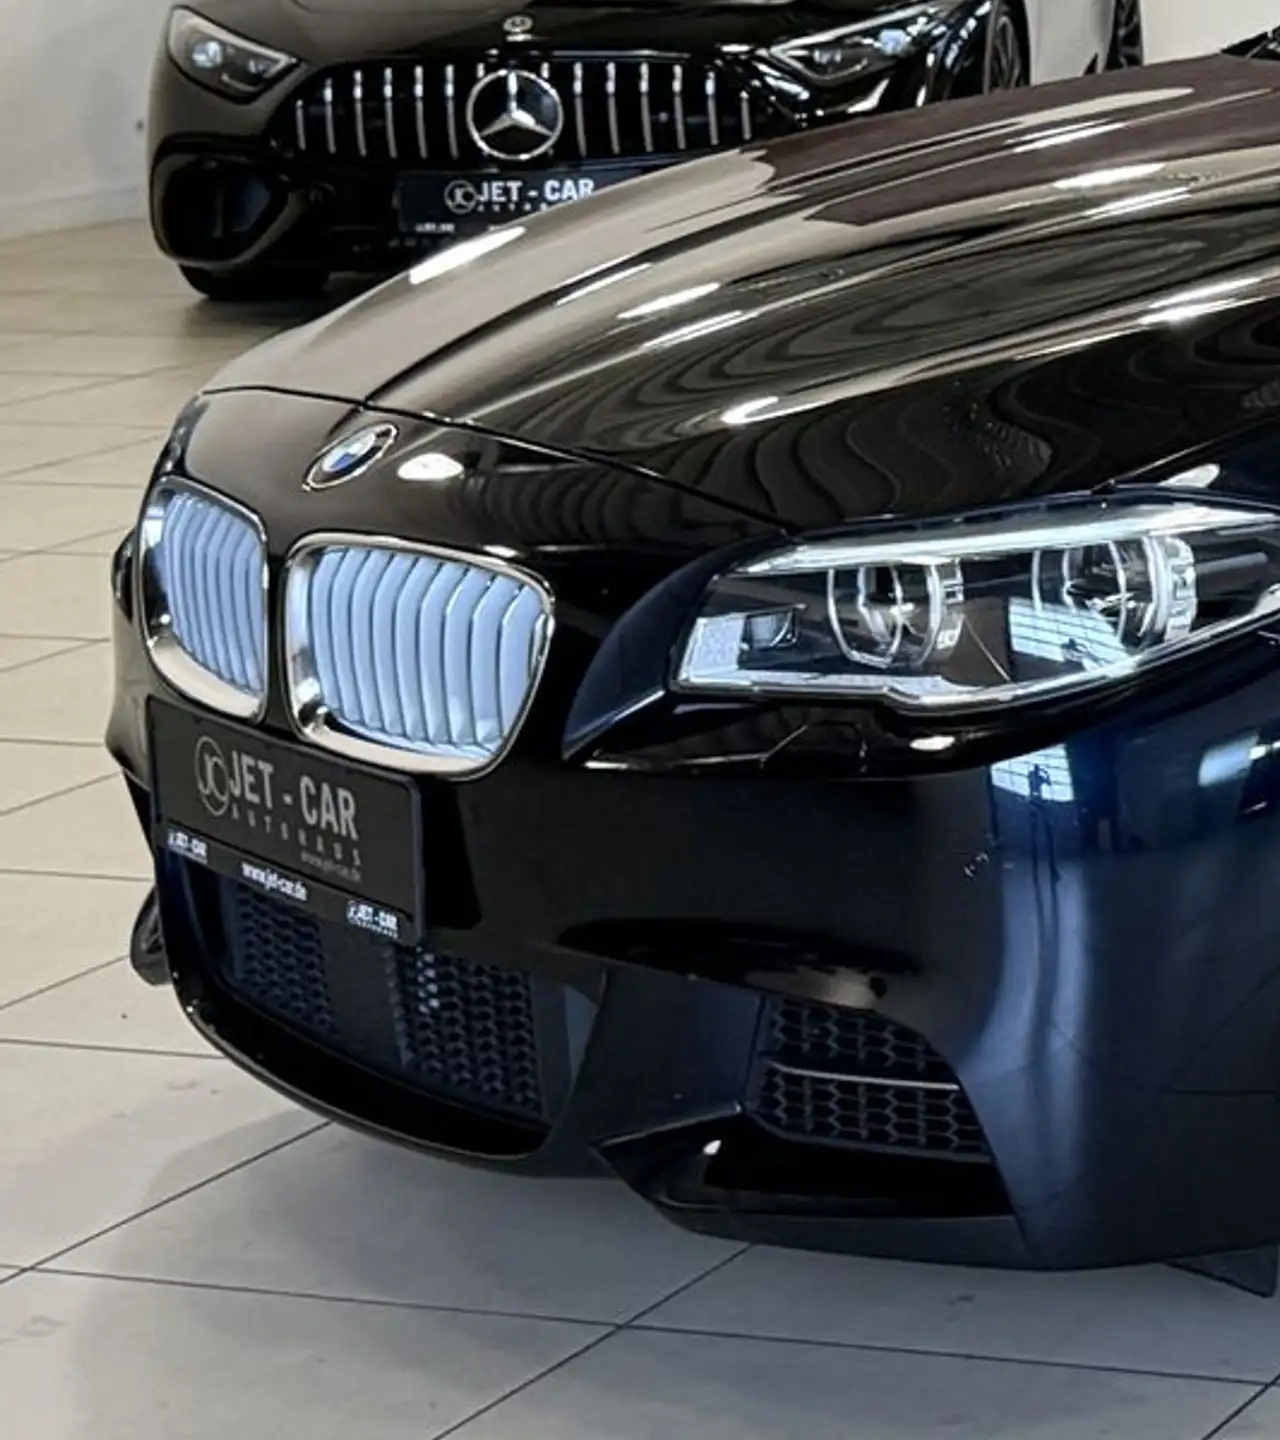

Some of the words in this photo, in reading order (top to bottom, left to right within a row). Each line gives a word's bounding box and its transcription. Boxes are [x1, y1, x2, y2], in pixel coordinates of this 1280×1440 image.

[475, 180, 523, 203] JET
[543, 177, 595, 202] CAR
[227, 750, 274, 809] JET
[299, 775, 359, 841] CAR
